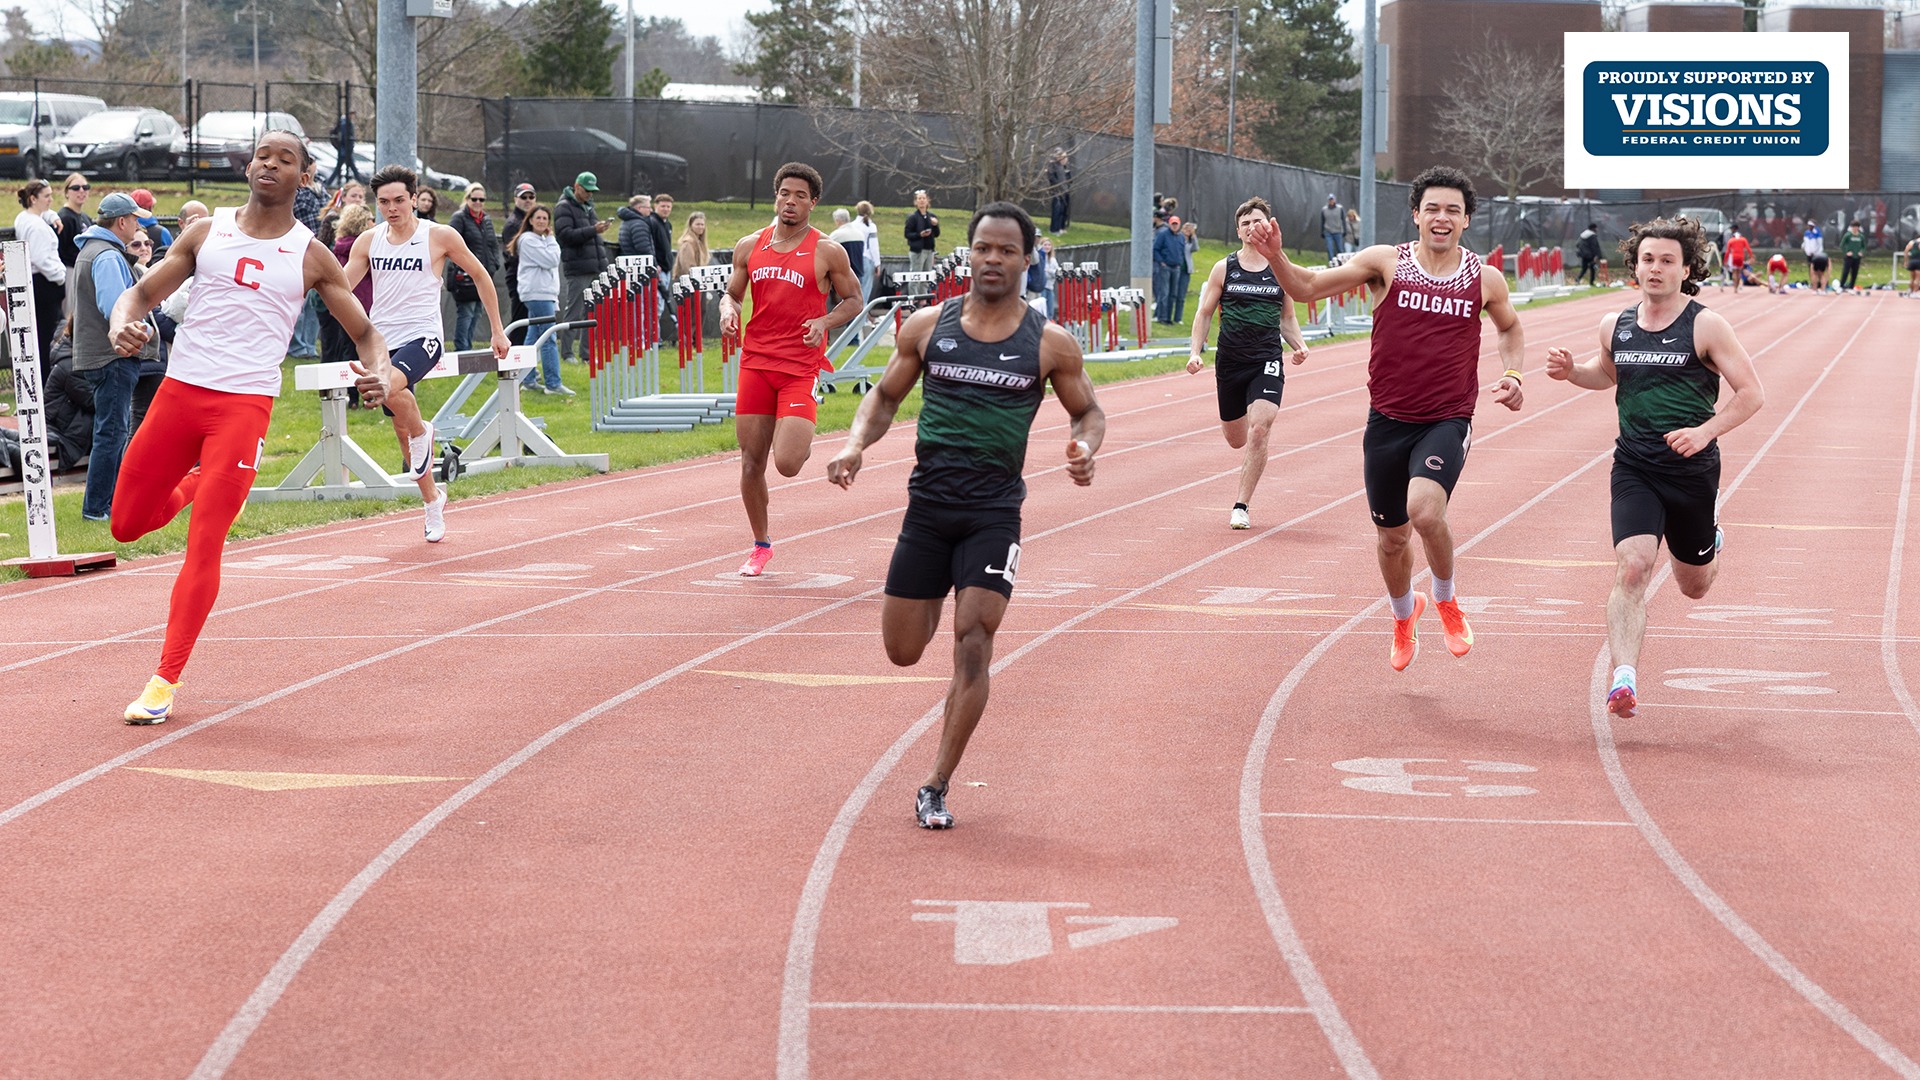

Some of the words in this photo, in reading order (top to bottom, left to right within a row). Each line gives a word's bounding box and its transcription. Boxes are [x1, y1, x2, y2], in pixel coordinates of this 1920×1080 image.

[233, 257, 264, 290] C
[371, 257, 423, 271] ITHACA
[752, 266, 804, 289] CORTLAND
[1227, 284, 1279, 294] BINGHAMTON
[1397, 290, 1474, 318] COLGATE
[1266, 361, 1278, 374] 5
[1614, 352, 1687, 365] BINGHAMTON
[929, 364, 1032, 388] BINGHAMTON
[7, 286, 49, 526] FINISH
